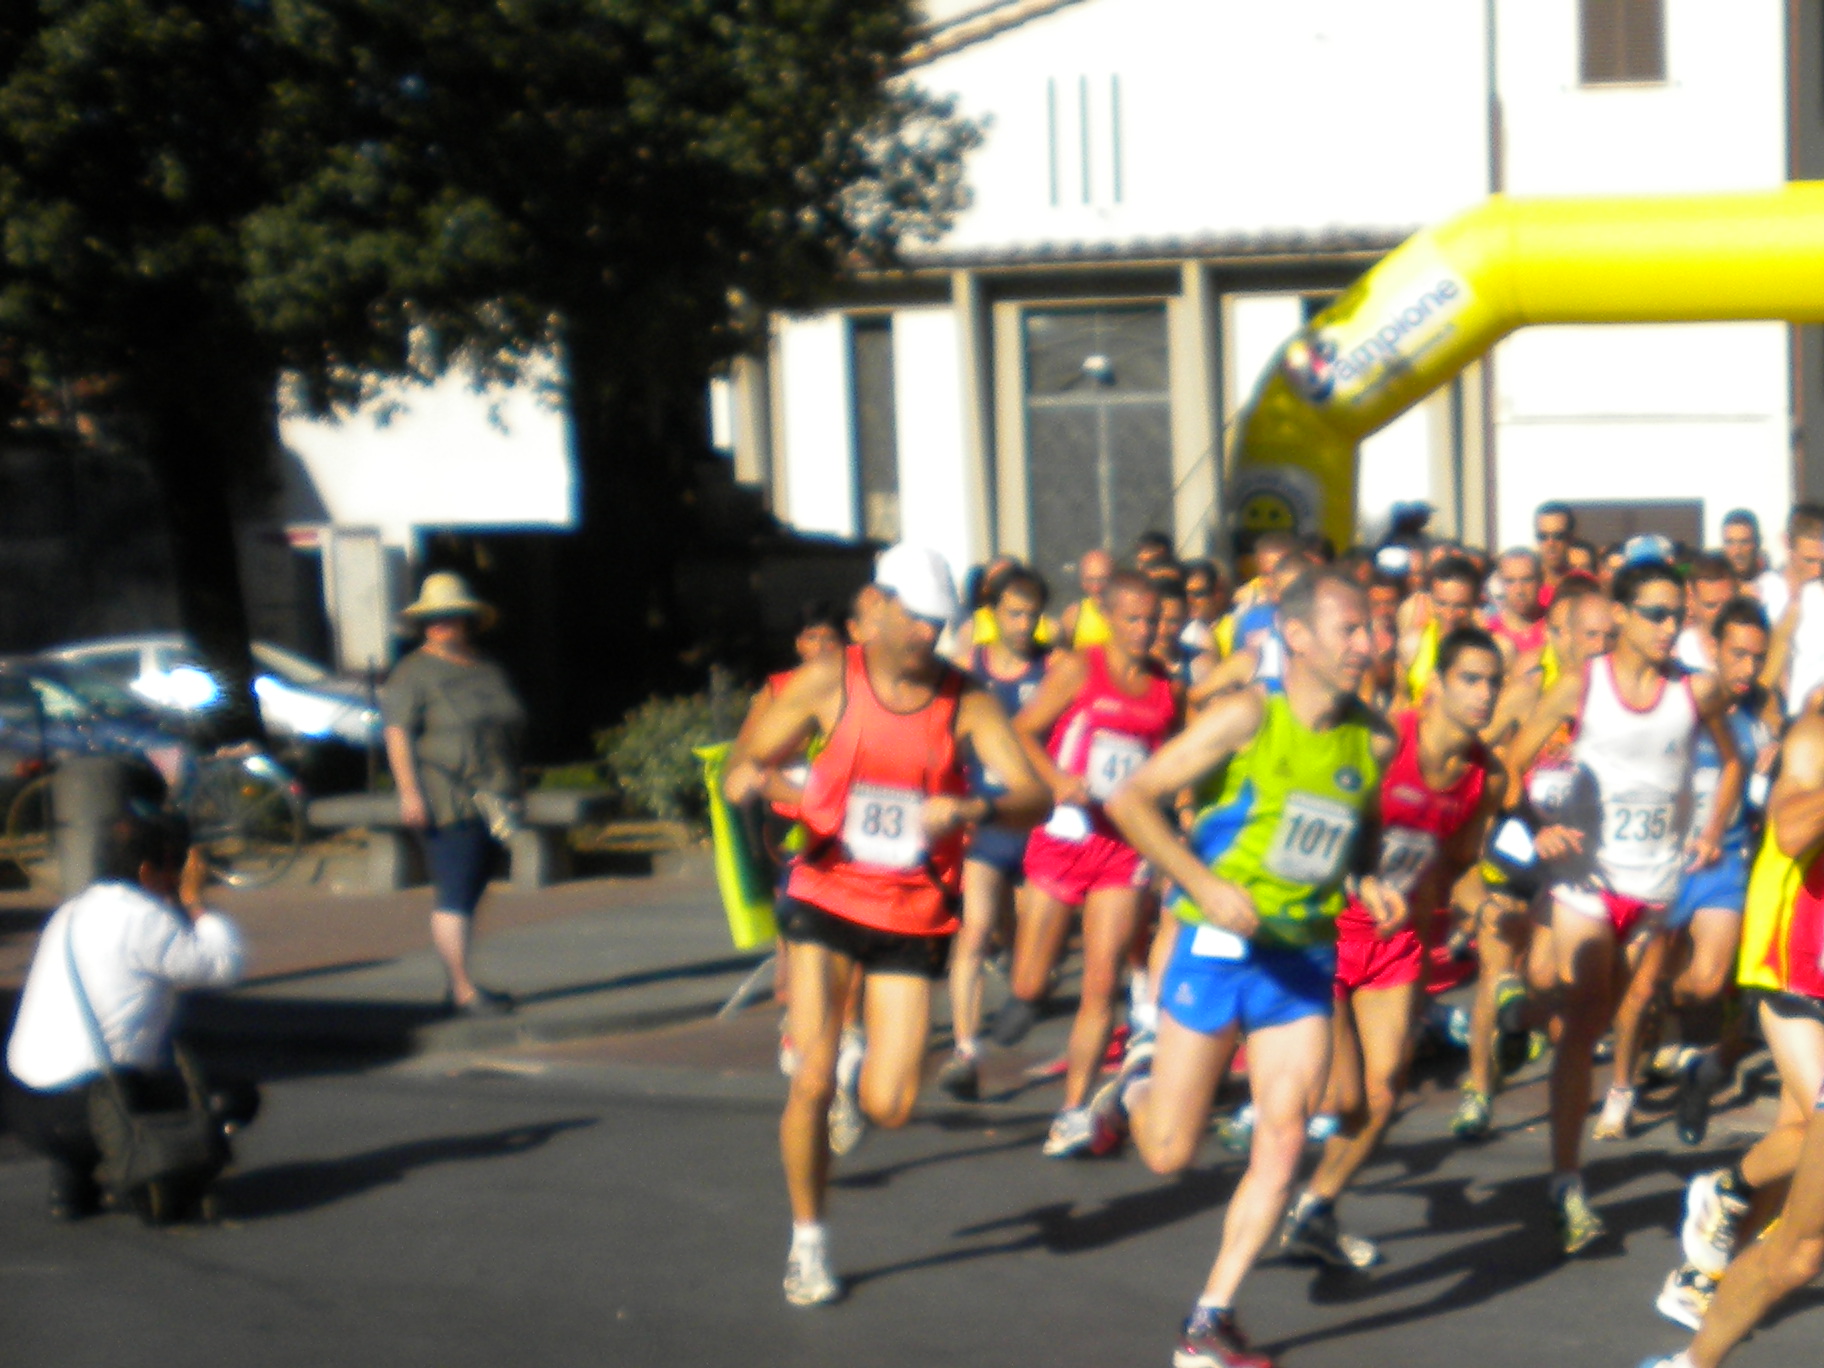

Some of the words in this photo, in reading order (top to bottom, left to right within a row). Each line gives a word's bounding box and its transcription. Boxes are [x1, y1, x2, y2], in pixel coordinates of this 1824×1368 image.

[862, 802, 904, 839] 83
[1284, 812, 1345, 859] 101
[1613, 807, 1668, 841] 235
